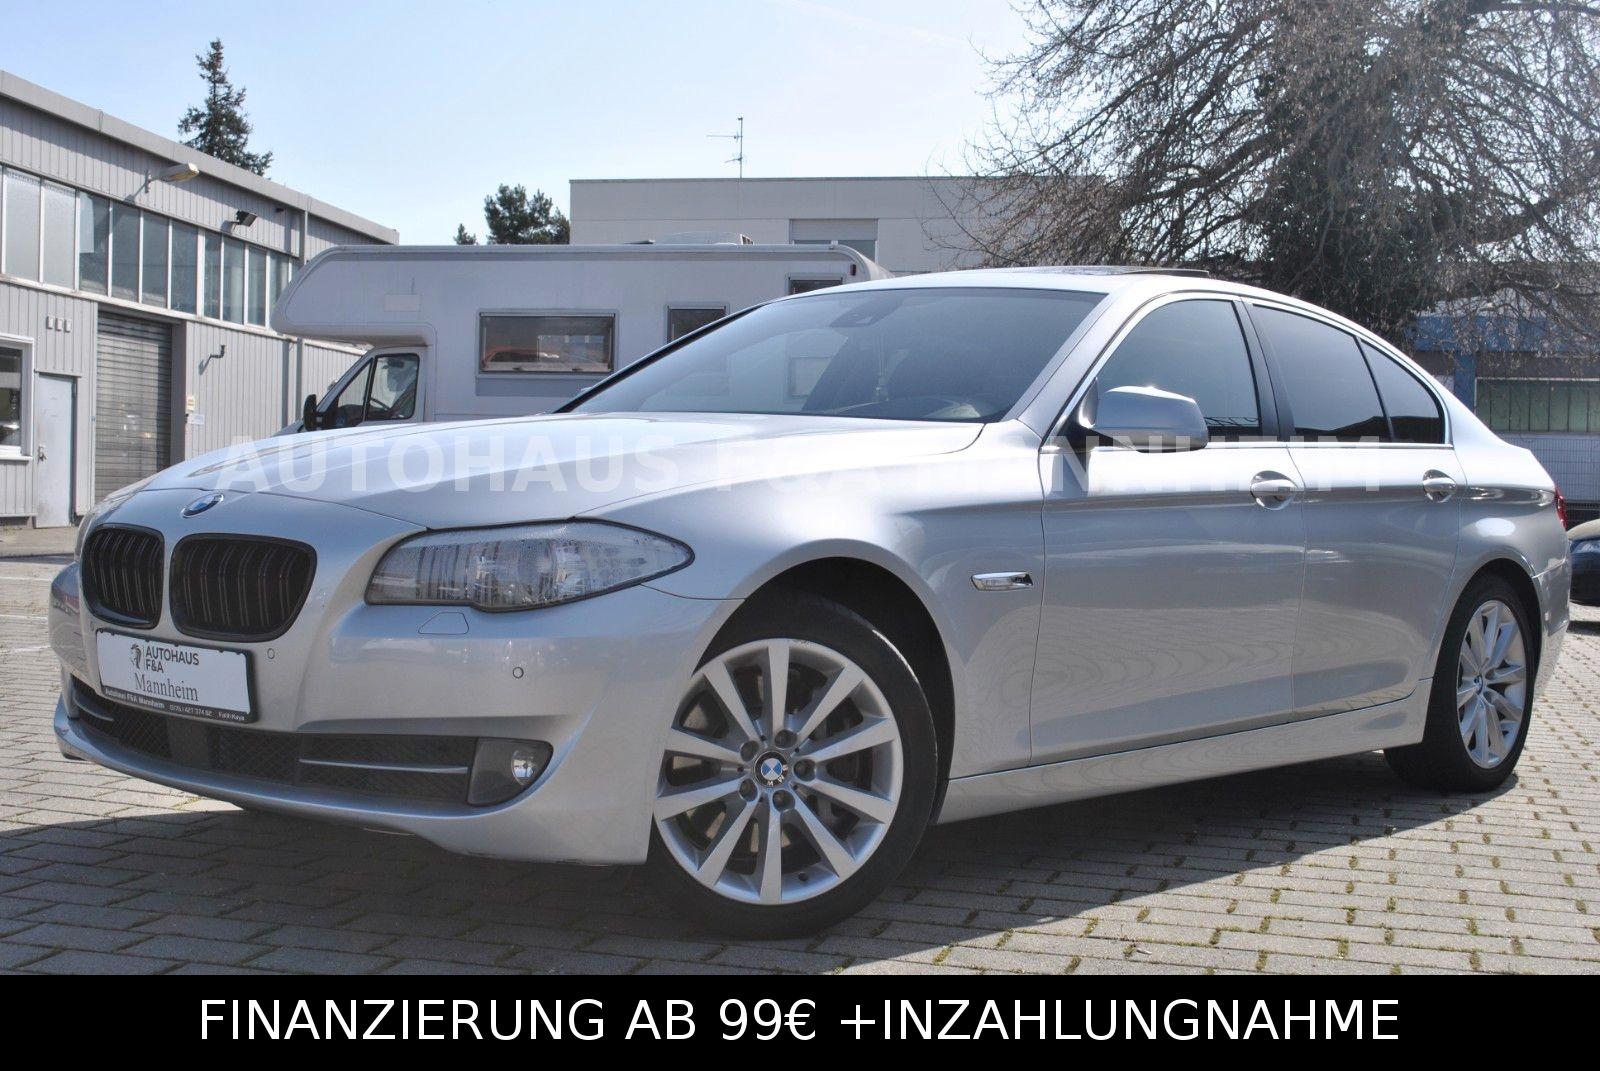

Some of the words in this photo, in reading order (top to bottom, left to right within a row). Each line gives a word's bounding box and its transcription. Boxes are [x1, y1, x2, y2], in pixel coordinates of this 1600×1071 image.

[145, 645, 200, 666] AUTOHAUS
[146, 659, 165, 673] F&A
[134, 672, 199, 701] Mannheim
